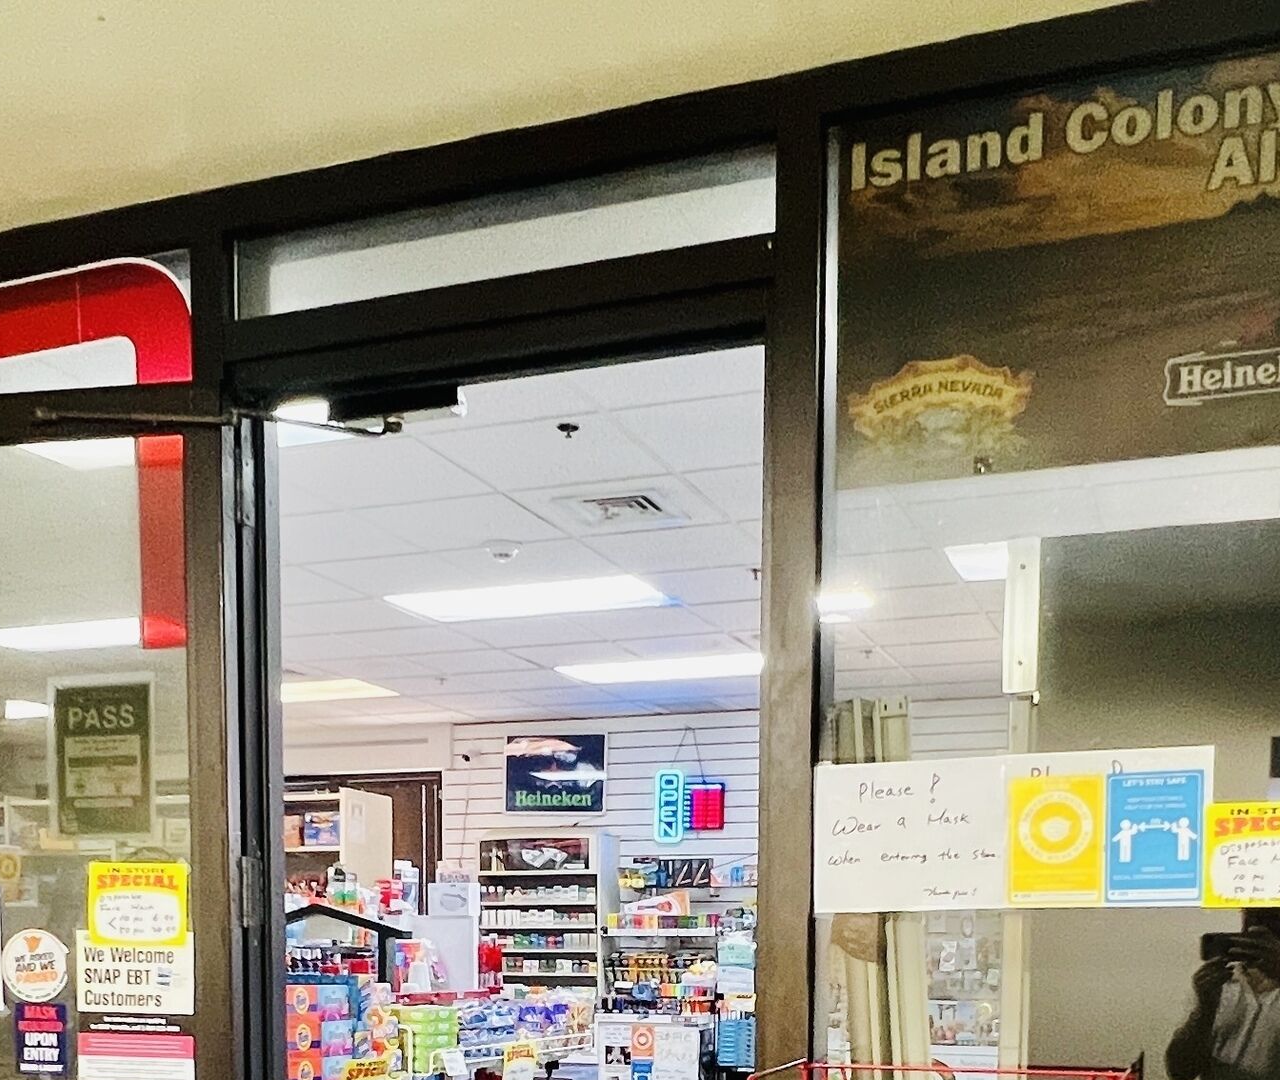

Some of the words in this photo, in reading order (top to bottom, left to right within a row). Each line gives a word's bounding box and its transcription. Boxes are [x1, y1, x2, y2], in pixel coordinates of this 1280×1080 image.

[851, 110, 1044, 191] Island
[872, 382, 935, 415] SIERRA
[937, 379, 1005, 400] NEVADA
[68, 703, 135, 729] PASS
[514, 789, 593, 807] Heineken
[858, 781, 915, 803] Please
[659, 773, 679, 838] OPEN
[831, 816, 882, 837] Wear
[896, 816, 907, 829] a
[927, 808, 970, 826] Mask
[937, 848, 961, 860] the
[1227, 855, 1259, 868] Face
[97, 874, 180, 891] SPECIAL
[84, 947, 105, 963] We
[110, 947, 175, 964] Welcome
[15, 962, 37, 973] AND
[39, 959, 56, 971] WE
[84, 967, 121, 985] SNAP
[126, 968, 152, 986] EBT
[84, 989, 163, 1008] Customers
[24, 1032, 59, 1047] UPON
[23, 1046, 60, 1062] ENTRY
